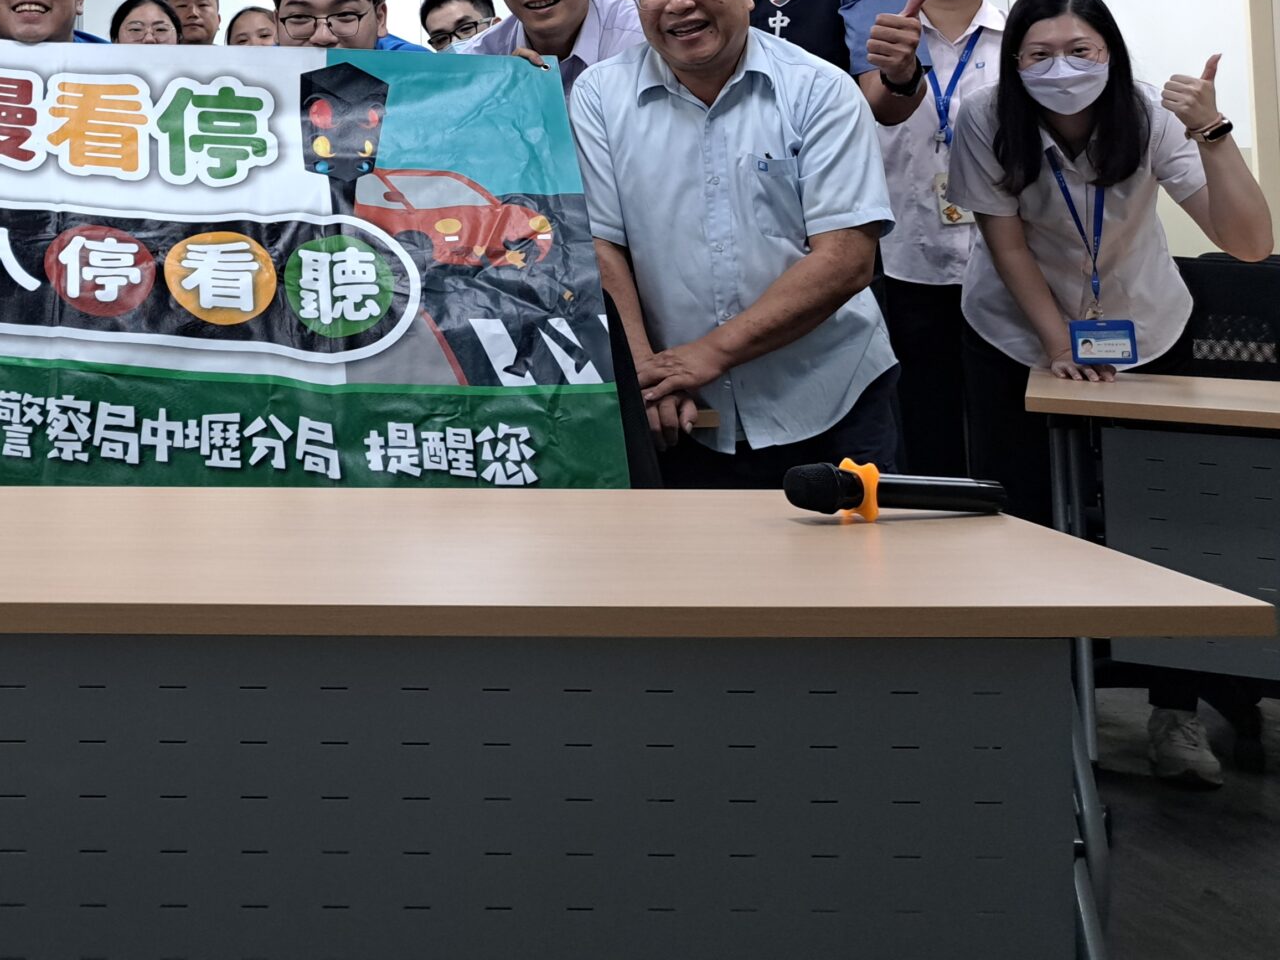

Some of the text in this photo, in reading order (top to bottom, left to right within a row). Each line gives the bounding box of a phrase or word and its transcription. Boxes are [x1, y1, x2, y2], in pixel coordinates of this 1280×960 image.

[768, 10, 791, 40] 中
[363, 421, 539, 486] 提醒您
